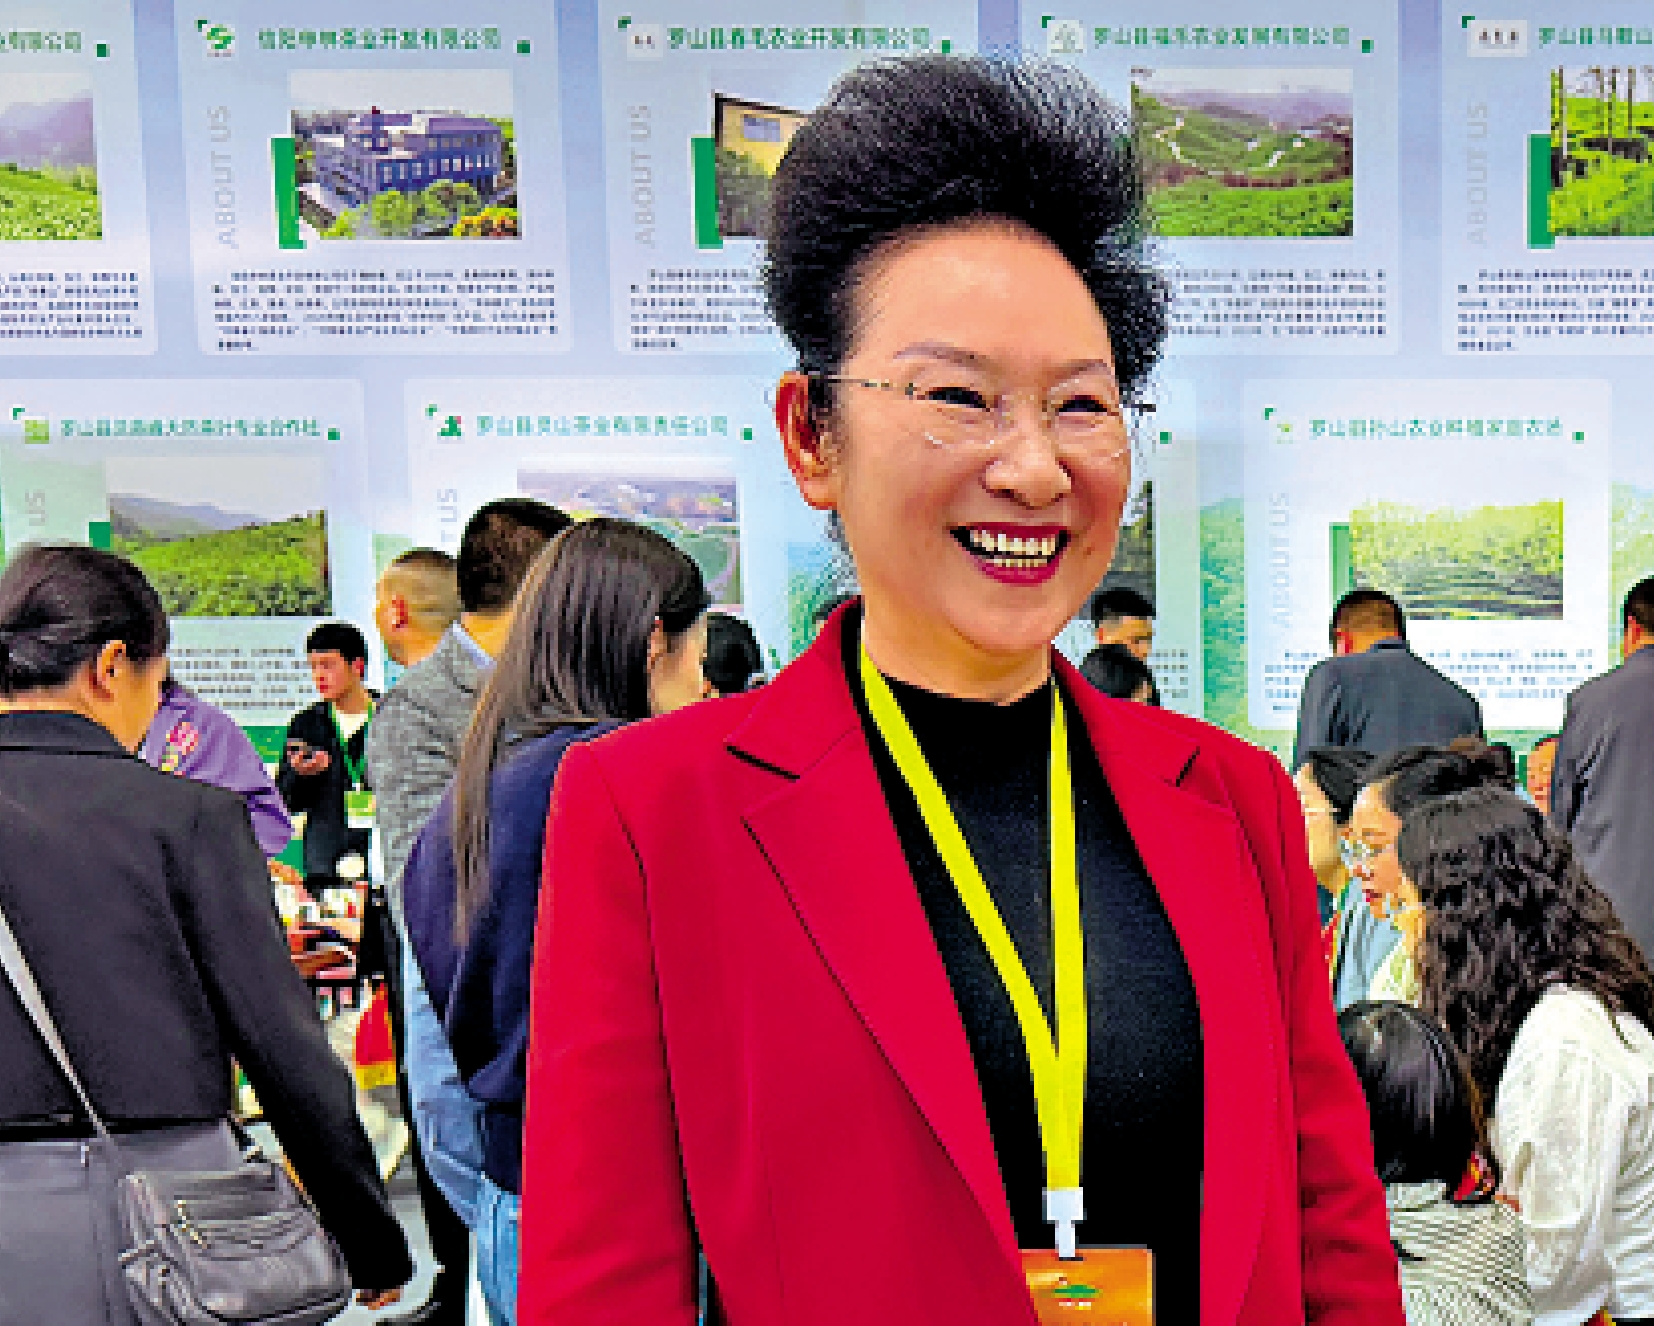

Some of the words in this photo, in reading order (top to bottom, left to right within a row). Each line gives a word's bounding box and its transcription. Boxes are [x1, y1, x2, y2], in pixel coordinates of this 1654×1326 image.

[0, 31, 82, 54] 有限公司
[207, 106, 231, 142] US
[627, 106, 651, 142] US
[1467, 102, 1487, 140] US
[211, 151, 239, 249] ABOUT
[631, 148, 655, 249] ABOUT
[1467, 147, 1487, 249] ABOUT
